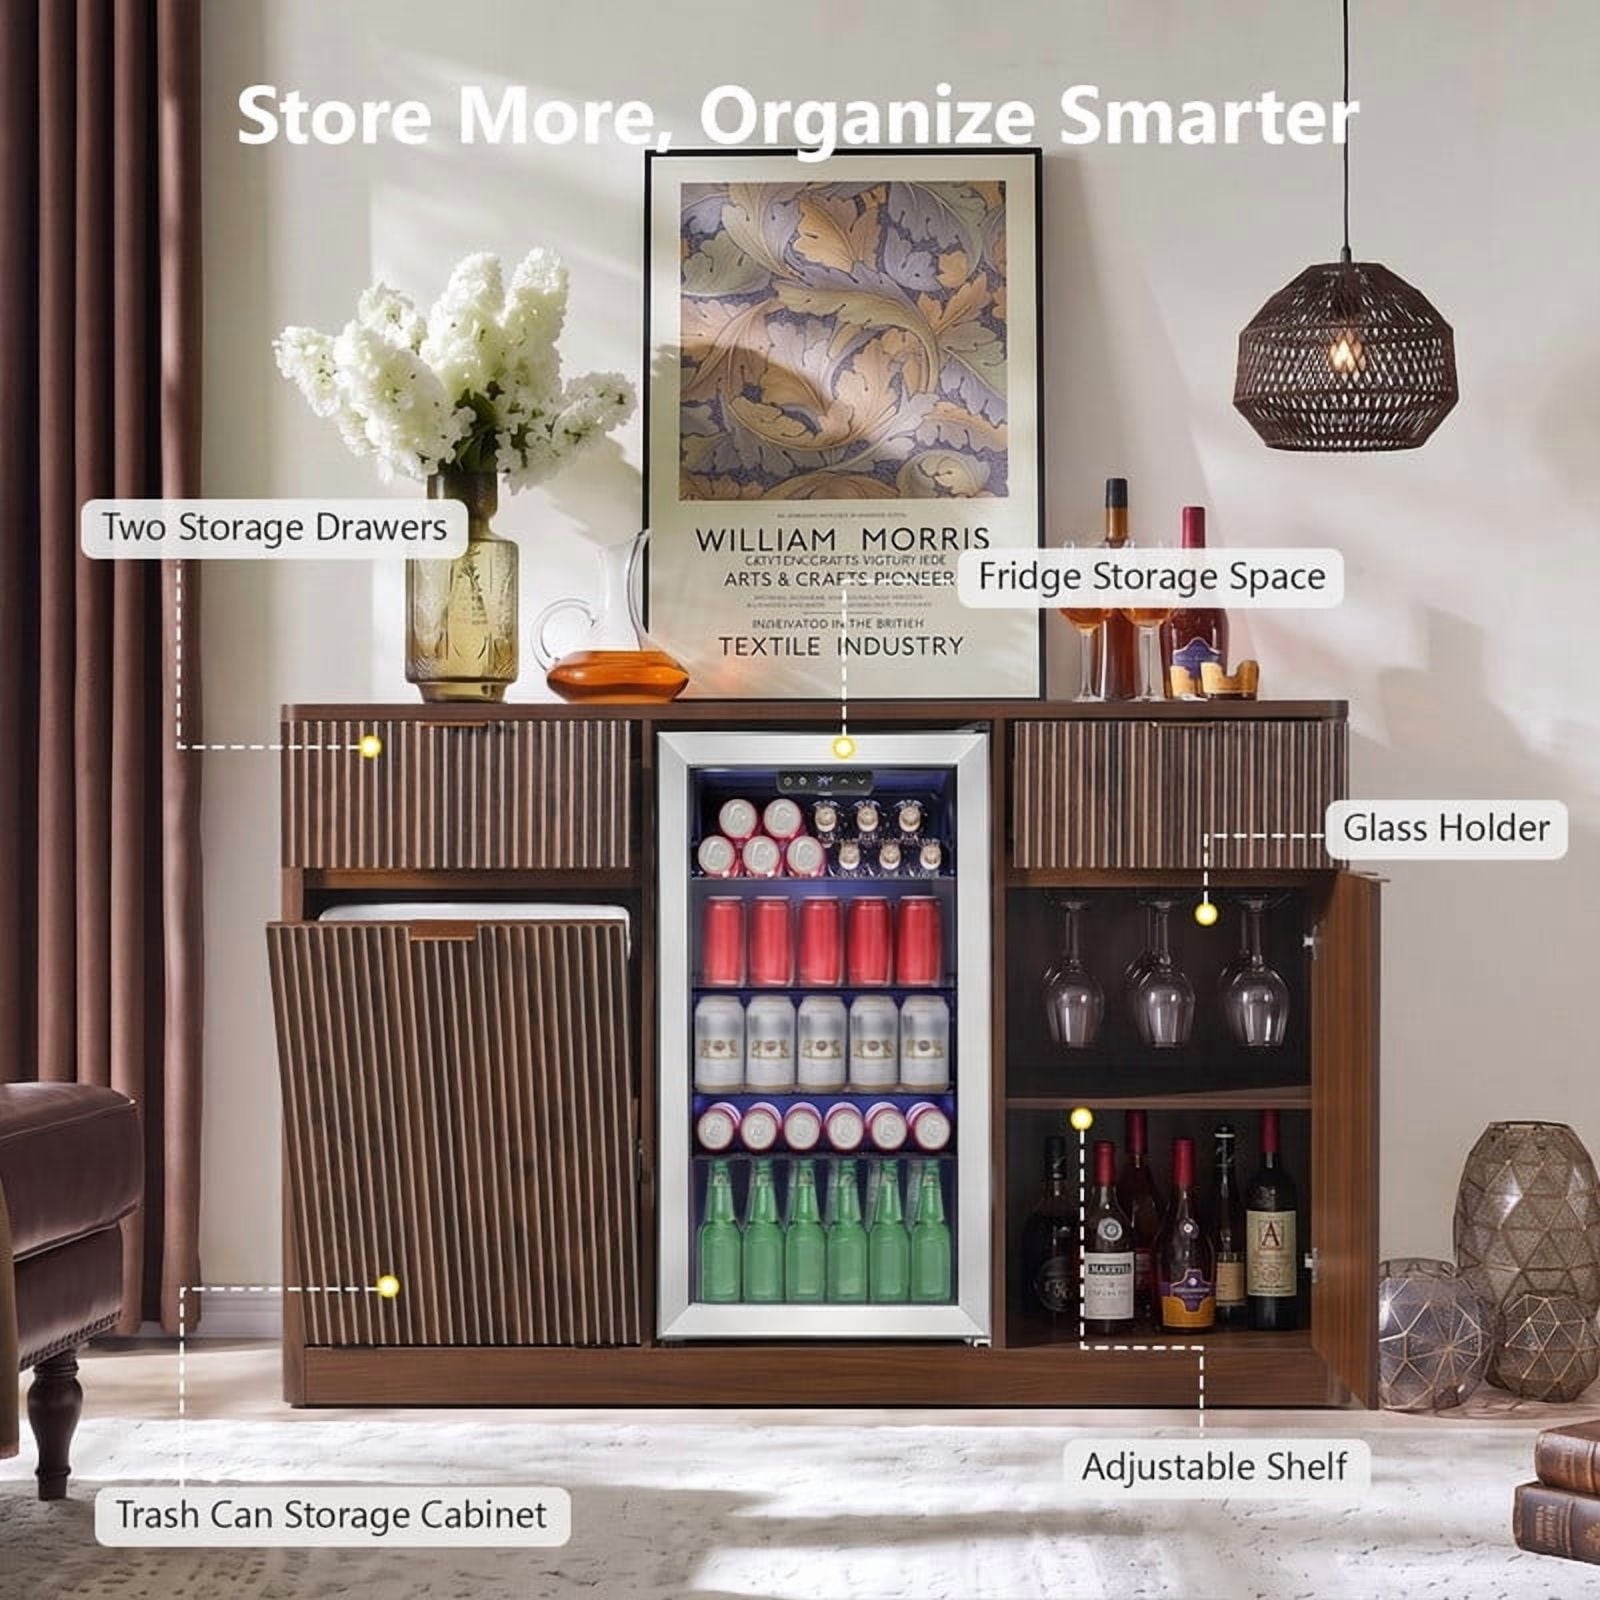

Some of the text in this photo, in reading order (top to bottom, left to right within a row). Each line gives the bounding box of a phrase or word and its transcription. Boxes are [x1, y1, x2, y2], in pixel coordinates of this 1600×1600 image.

[695, 527, 990, 552] WILLIAM MORRIS
[724, 571, 955, 587] ARTS & CRAFTS PIONEER
[849, 618, 872, 629] THE
[719, 636, 964, 656] TEXTILE INDUSTRY
